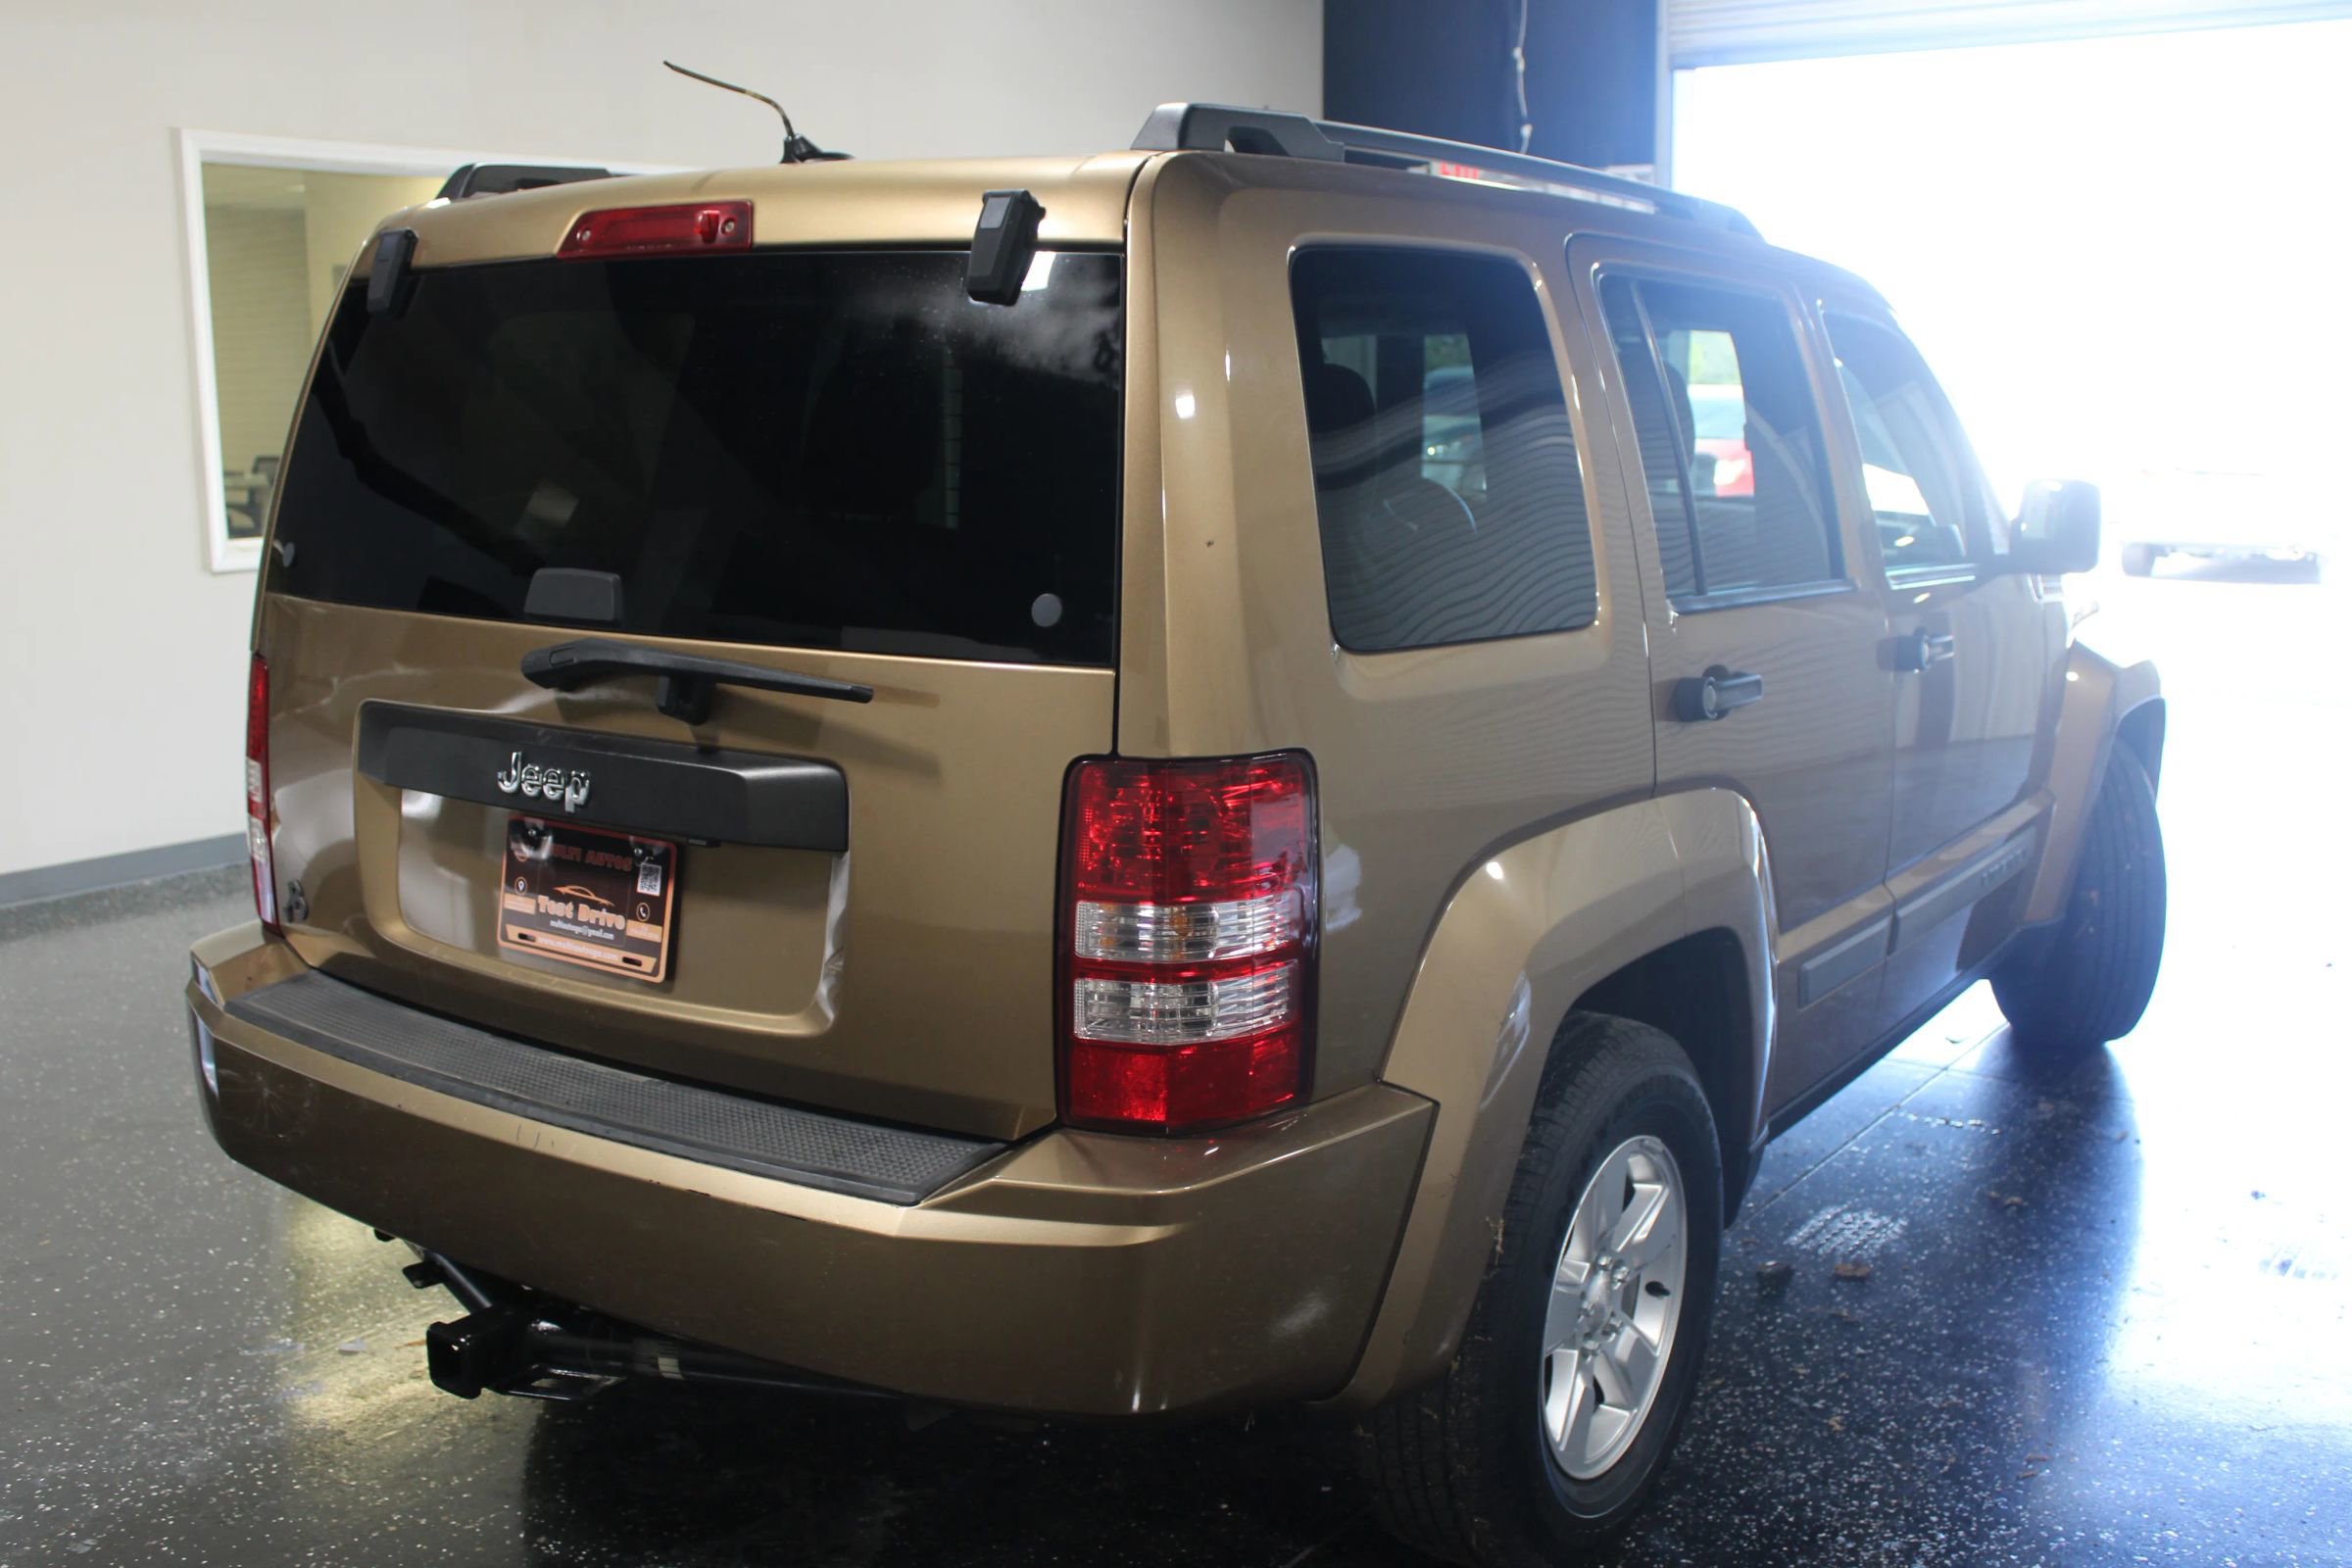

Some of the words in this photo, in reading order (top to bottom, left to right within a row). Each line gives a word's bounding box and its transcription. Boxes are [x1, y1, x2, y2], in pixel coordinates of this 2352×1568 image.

[498, 751, 592, 812] Jeep
[537, 894, 573, 919] Test
[577, 903, 625, 930] Drive
